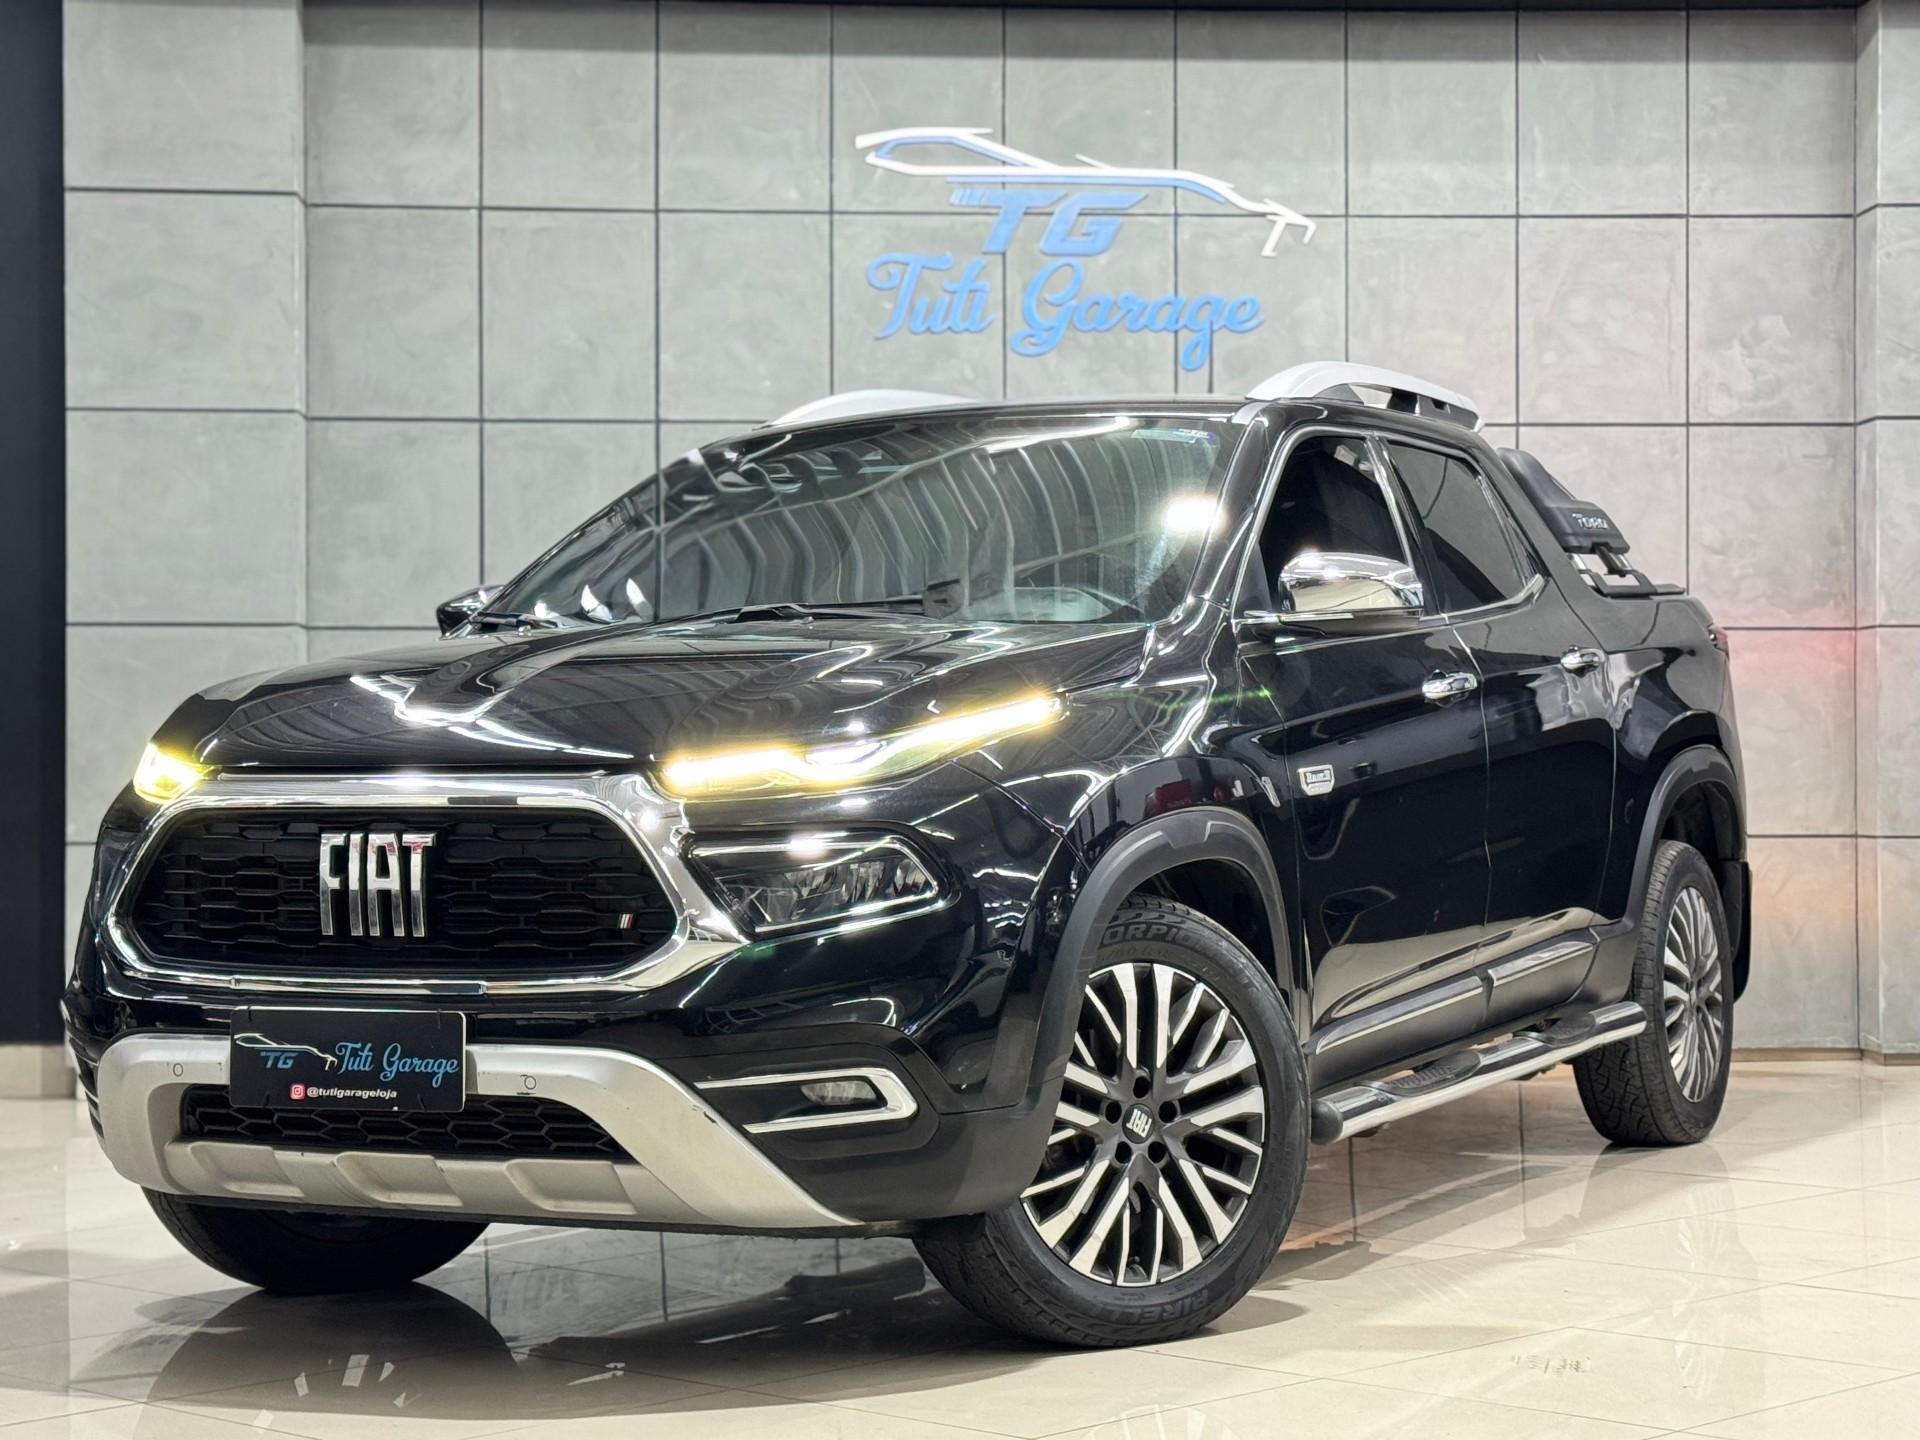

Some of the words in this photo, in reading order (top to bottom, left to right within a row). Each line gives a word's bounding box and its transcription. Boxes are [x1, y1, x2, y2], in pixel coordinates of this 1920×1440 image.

[949, 188, 1149, 257] TG
[866, 251, 996, 341] Tuti
[1010, 258, 1266, 372] Garage
[319, 831, 437, 938] FIAT
[259, 1051, 299, 1069] TG
[335, 1041, 375, 1075] Tuti
[379, 1042, 460, 1088] Garage
[306, 1086, 398, 1100] @tutigarageloja
